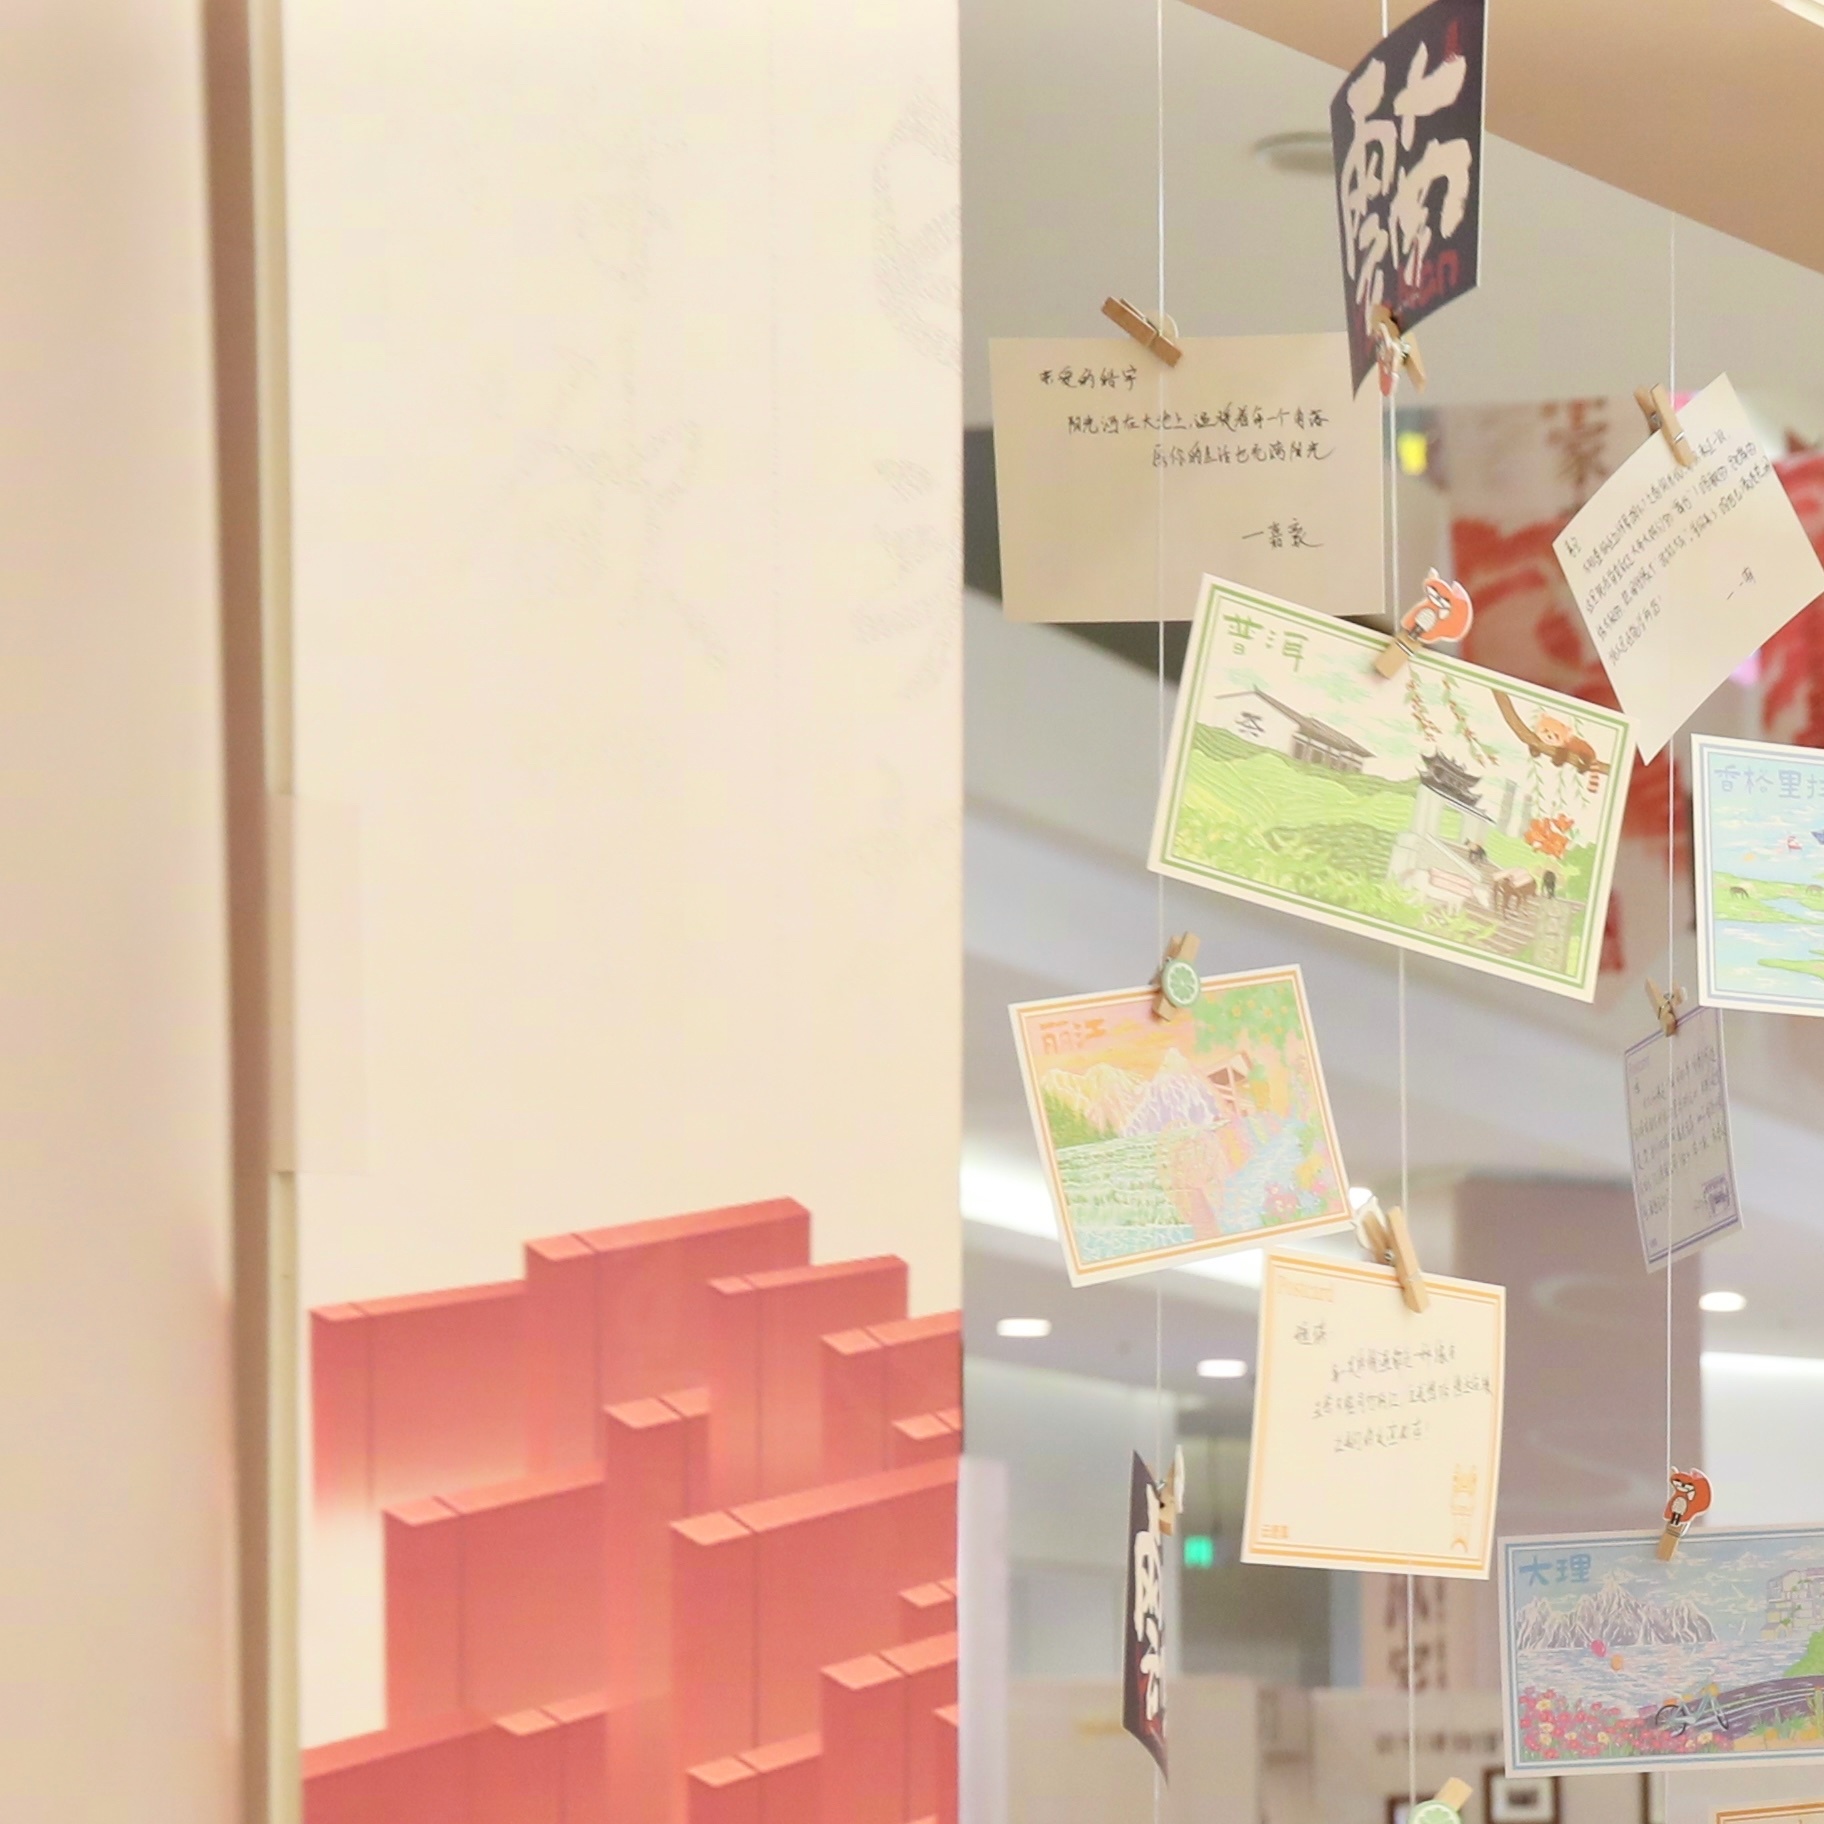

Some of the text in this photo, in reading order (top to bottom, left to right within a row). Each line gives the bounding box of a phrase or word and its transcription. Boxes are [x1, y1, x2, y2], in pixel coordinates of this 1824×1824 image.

[1222, 612, 1309, 673] 普洱
[1039, 1018, 1107, 1055] 丽江
[1518, 1553, 1592, 1586] 大理
